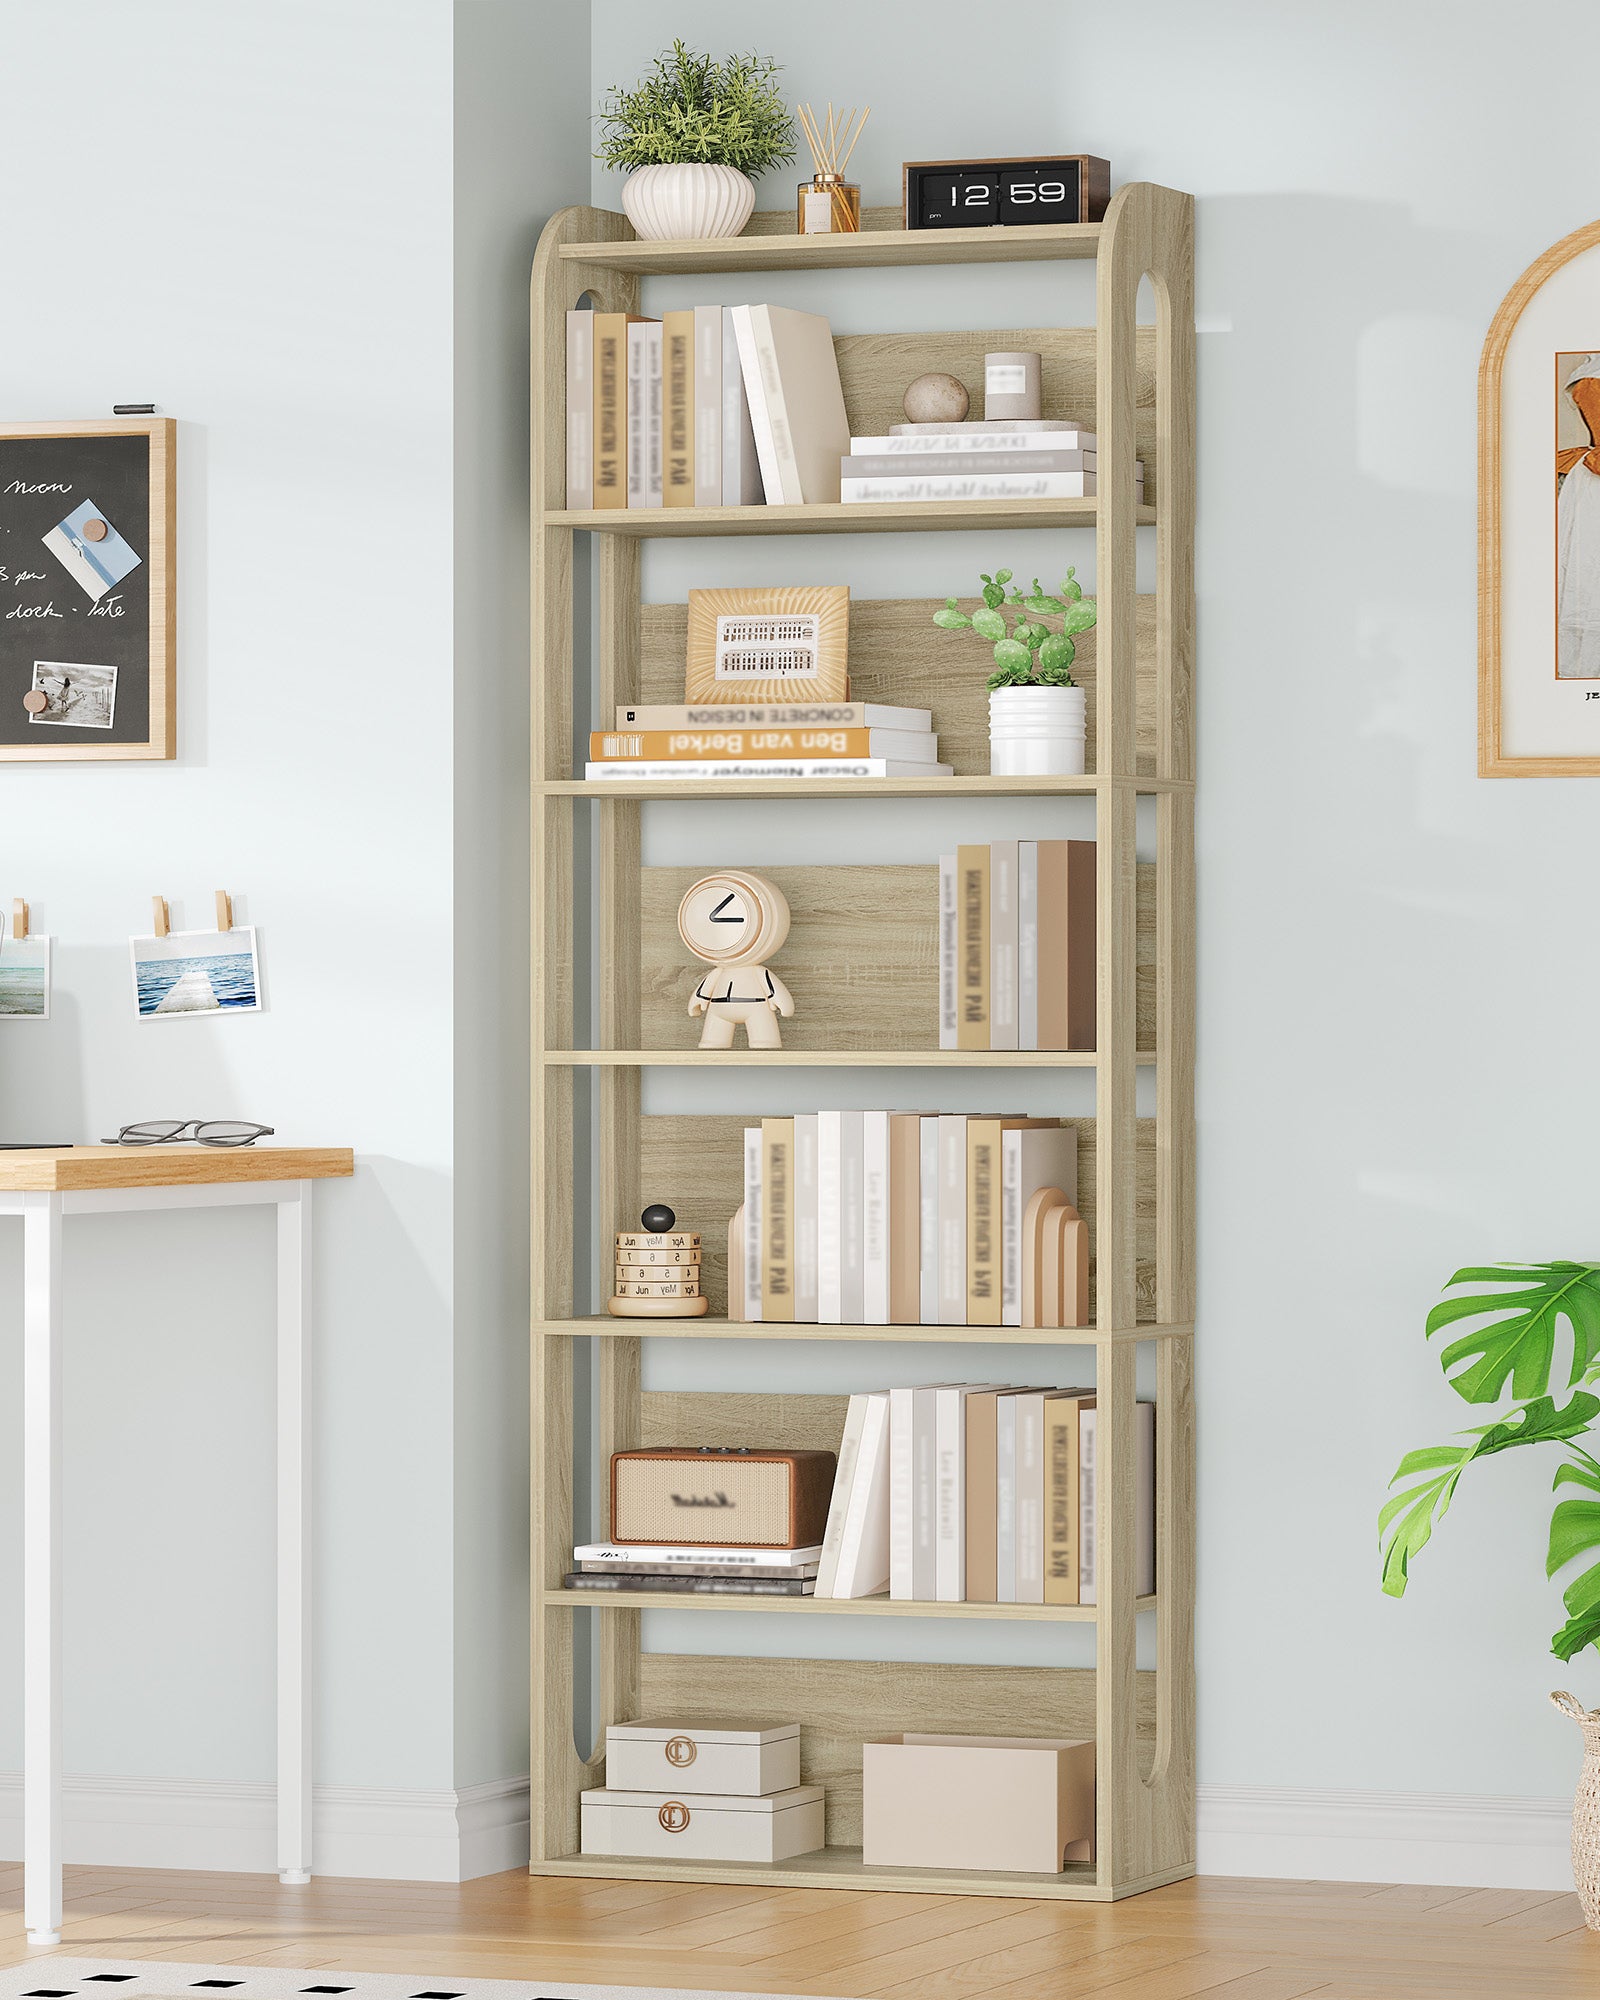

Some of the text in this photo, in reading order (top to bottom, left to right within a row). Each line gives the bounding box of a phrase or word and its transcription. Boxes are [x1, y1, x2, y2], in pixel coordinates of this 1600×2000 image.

[951, 182, 1066, 207] 12 59
[688, 708, 854, 724] CONCRETE IN DESIGN
[669, 732, 847, 754] Ben van Berkel
